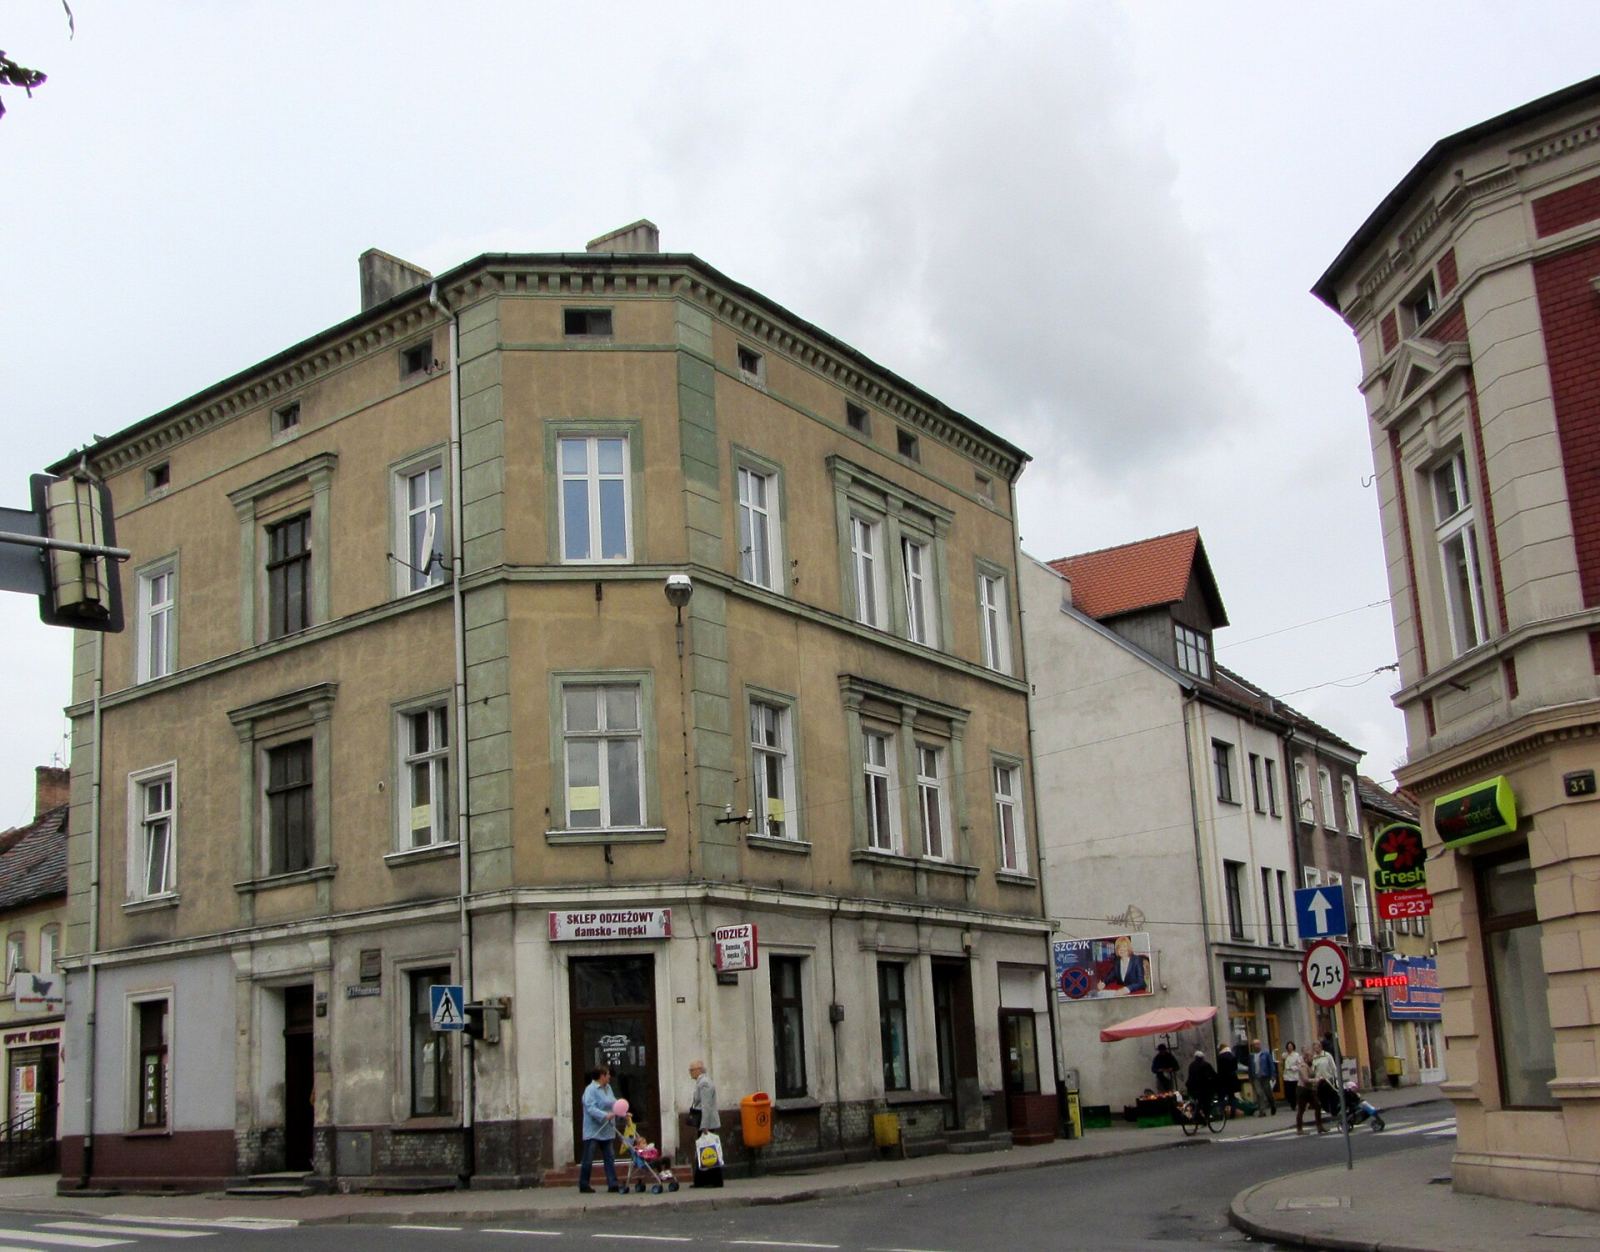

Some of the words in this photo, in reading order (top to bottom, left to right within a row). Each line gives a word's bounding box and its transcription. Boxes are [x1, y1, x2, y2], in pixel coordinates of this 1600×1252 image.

[1569, 780, 1586, 792] 31
[1381, 867, 1424, 884] Fresh
[566, 914, 597, 925] SKLEP
[599, 911, 654, 924] ODZIEŻOWY
[717, 926, 750, 941] ODZIEŻ
[1055, 940, 1090, 952] SZCZYK
[1365, 976, 1408, 988] PATKA
